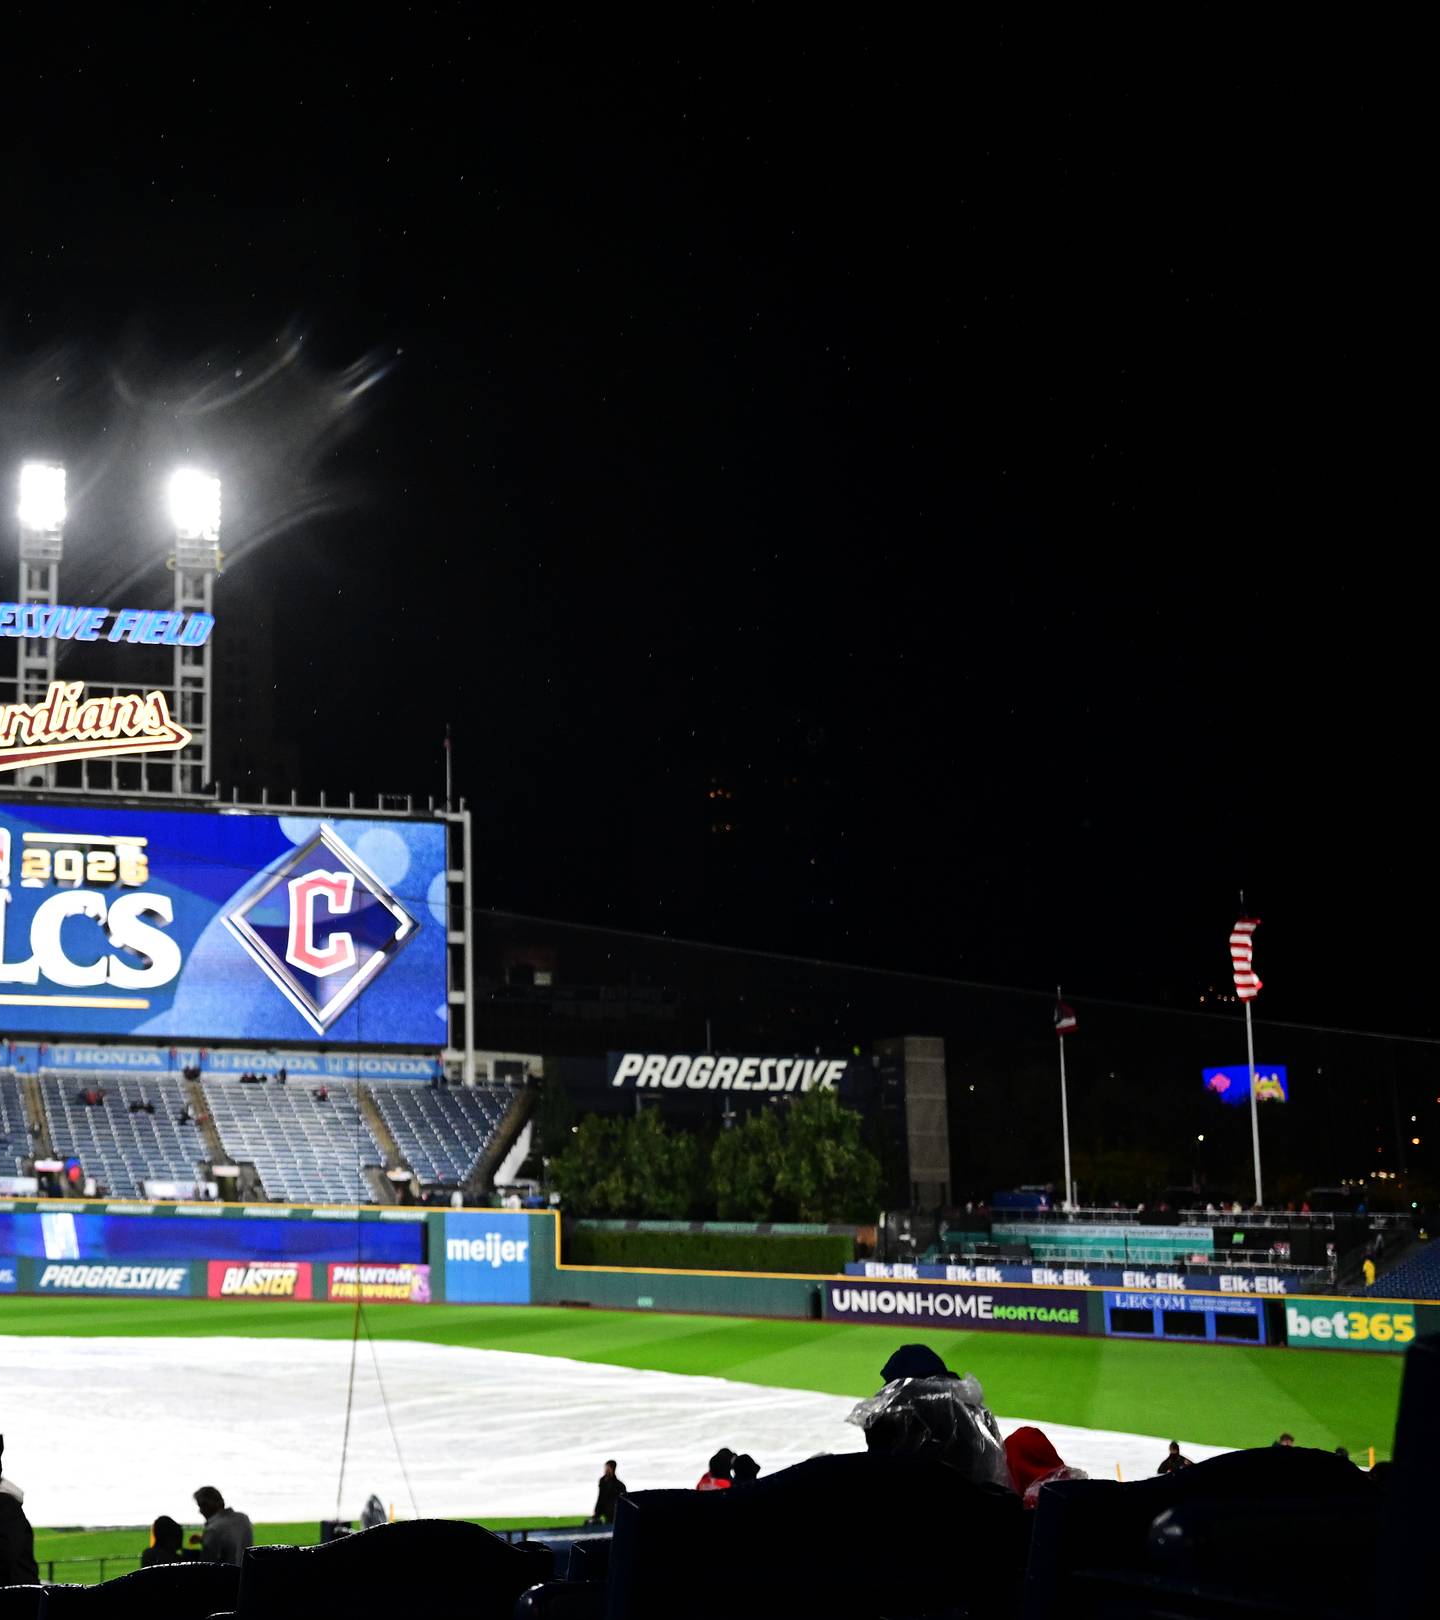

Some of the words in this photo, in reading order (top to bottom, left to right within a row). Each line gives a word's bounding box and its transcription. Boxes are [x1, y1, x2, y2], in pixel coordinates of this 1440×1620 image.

[108, 607, 215, 646] FIELD
[285, 869, 356, 977] C
[73, 1048, 162, 1066] HONDA
[232, 1053, 319, 1071] HONDA
[348, 1058, 433, 1075] HONDA
[612, 1053, 848, 1092] PROGRESSIVE
[446, 1233, 529, 1268] meijer
[39, 1264, 187, 1291] PROGRESSIVE
[220, 1267, 298, 1296] BLASTER
[333, 1266, 411, 1285] PHANTOM
[992, 1304, 1080, 1324] MORTGAGE
[1115, 1294, 1186, 1311] LECOM
[1285, 1308, 1415, 1342] bet365
